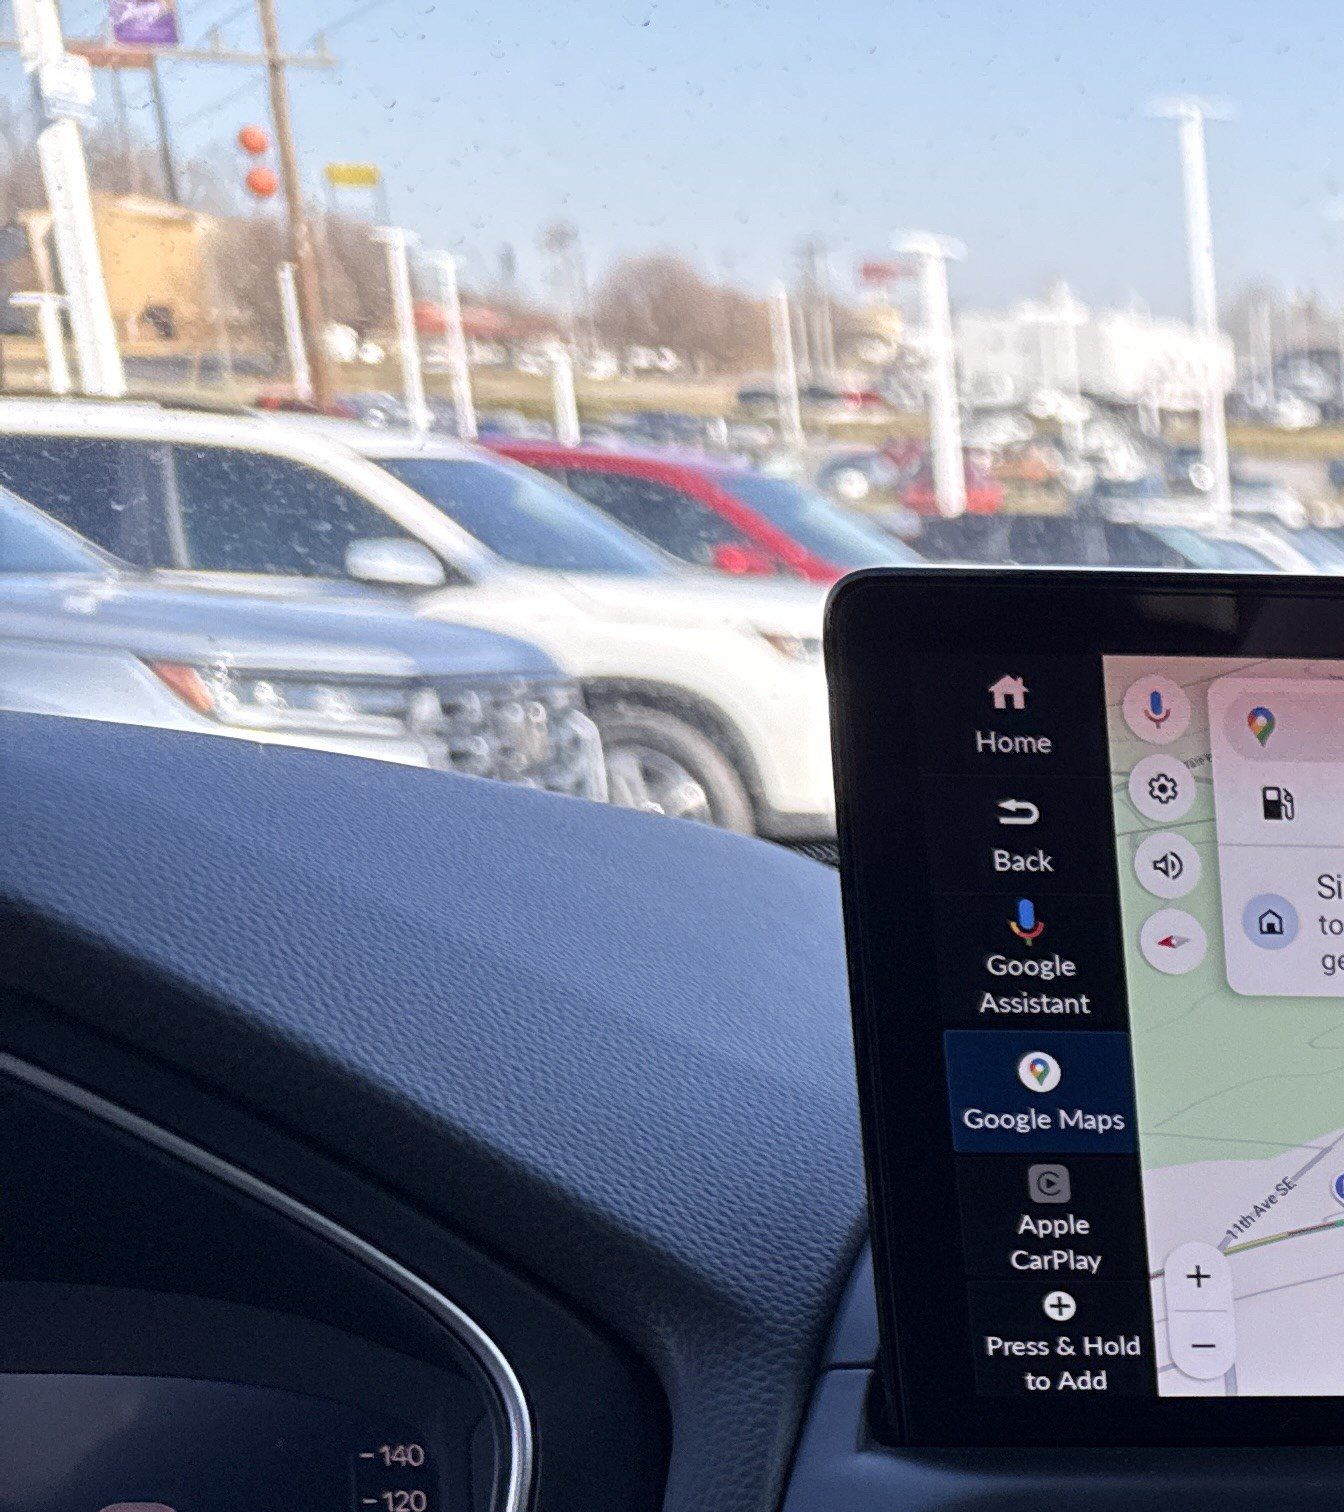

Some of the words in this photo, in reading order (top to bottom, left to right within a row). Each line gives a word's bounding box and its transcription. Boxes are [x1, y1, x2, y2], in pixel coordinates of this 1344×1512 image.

[976, 730, 1053, 754] Home
[993, 850, 1055, 873] Back
[1318, 916, 1344, 936] to
[986, 954, 1077, 981] Google
[979, 991, 1092, 1015] Assistant
[963, 1108, 1052, 1133] Google
[1060, 1109, 1126, 1134] Maps
[1225, 1212, 1257, 1241] 11th
[1251, 1191, 1279, 1218] Ave
[1273, 1175, 1299, 1201] SE
[1018, 1213, 1091, 1238] Apple
[1010, 1250, 1102, 1275] CarPlay
[985, 1336, 1050, 1357] Press
[1055, 1336, 1076, 1357] &
[1083, 1335, 1141, 1357] Hold
[1024, 1371, 1051, 1392] to
[1057, 1370, 1109, 1392] Add
[380, 1443, 425, 1467] 140
[382, 1490, 428, 1512] 120
